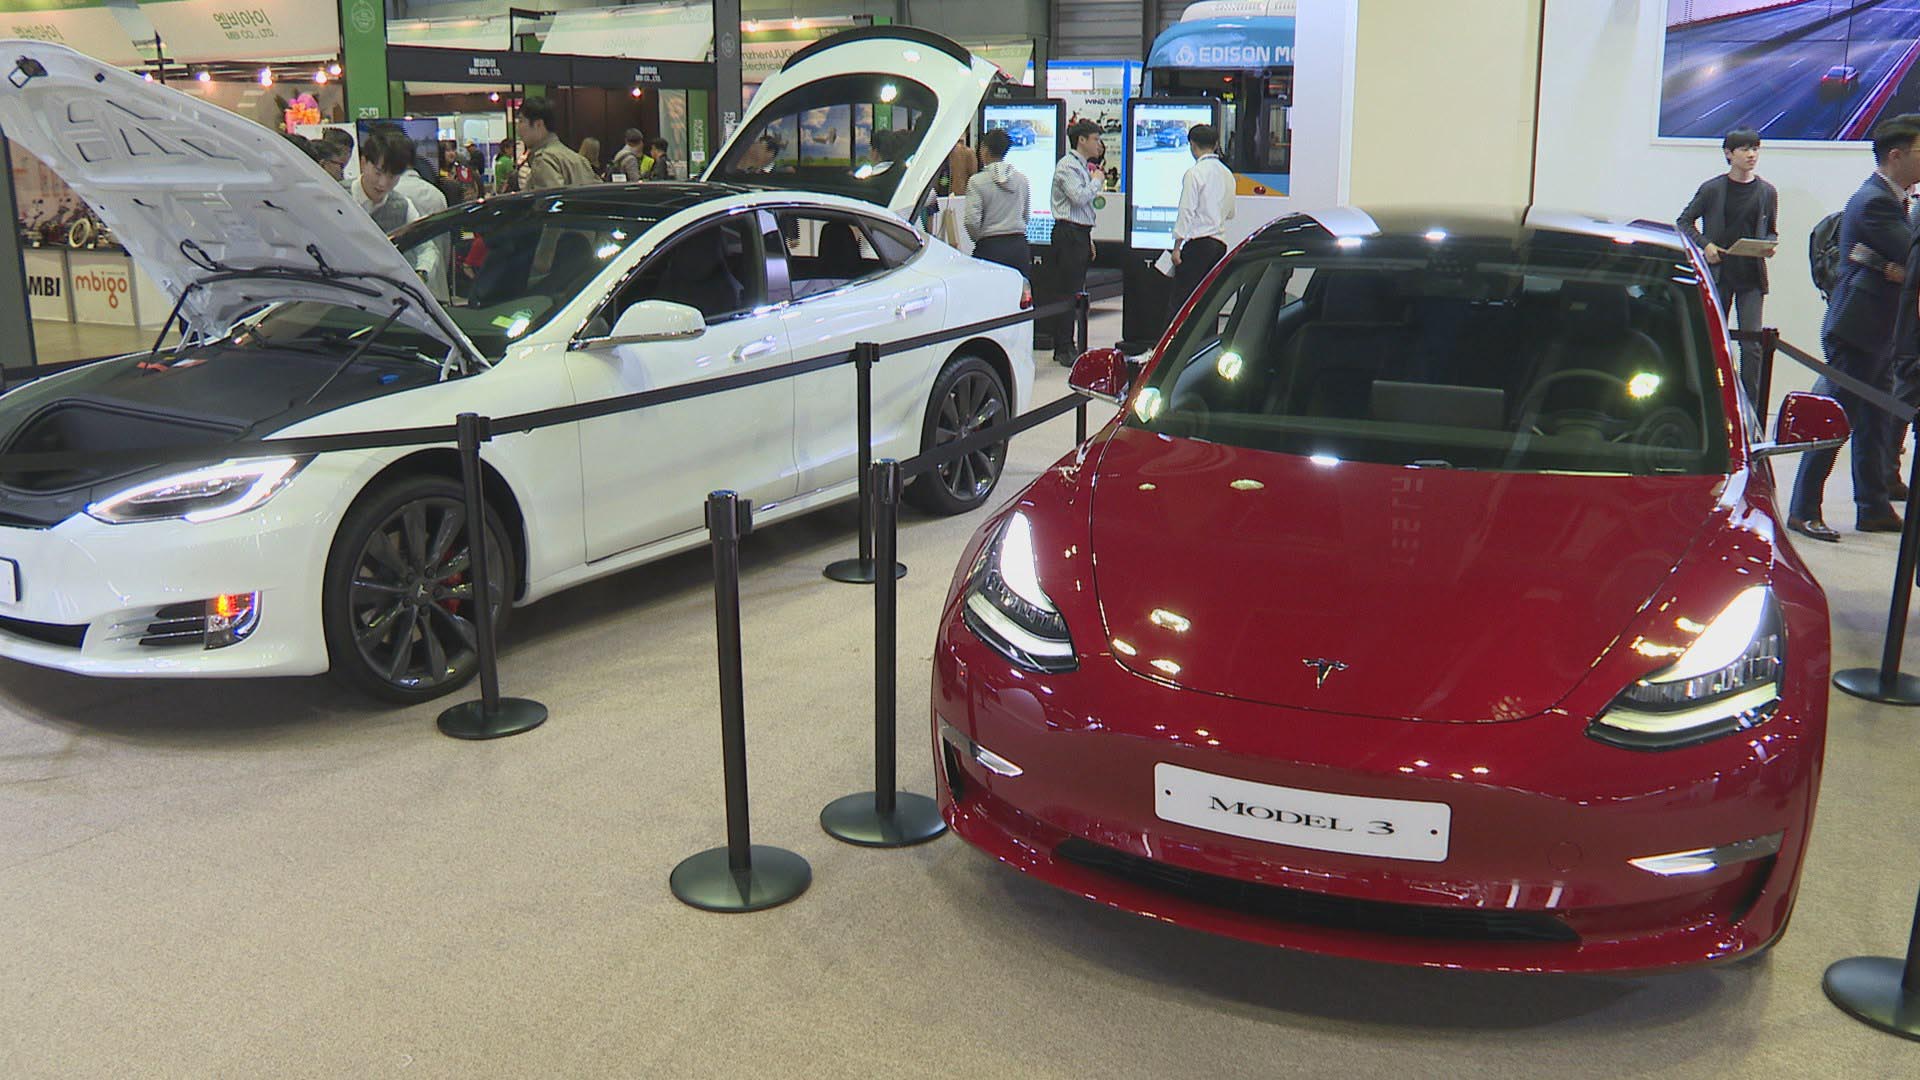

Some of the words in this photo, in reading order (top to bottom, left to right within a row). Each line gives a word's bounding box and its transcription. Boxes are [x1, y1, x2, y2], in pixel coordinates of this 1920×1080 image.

[213, 8, 272, 29] 엠비아이
[1199, 46, 1270, 64] EDISON
[28, 276, 60, 297] MBI
[75, 271, 128, 309] mbigo
[1208, 795, 1353, 832] MODEL
[1367, 820, 1395, 836] 3
